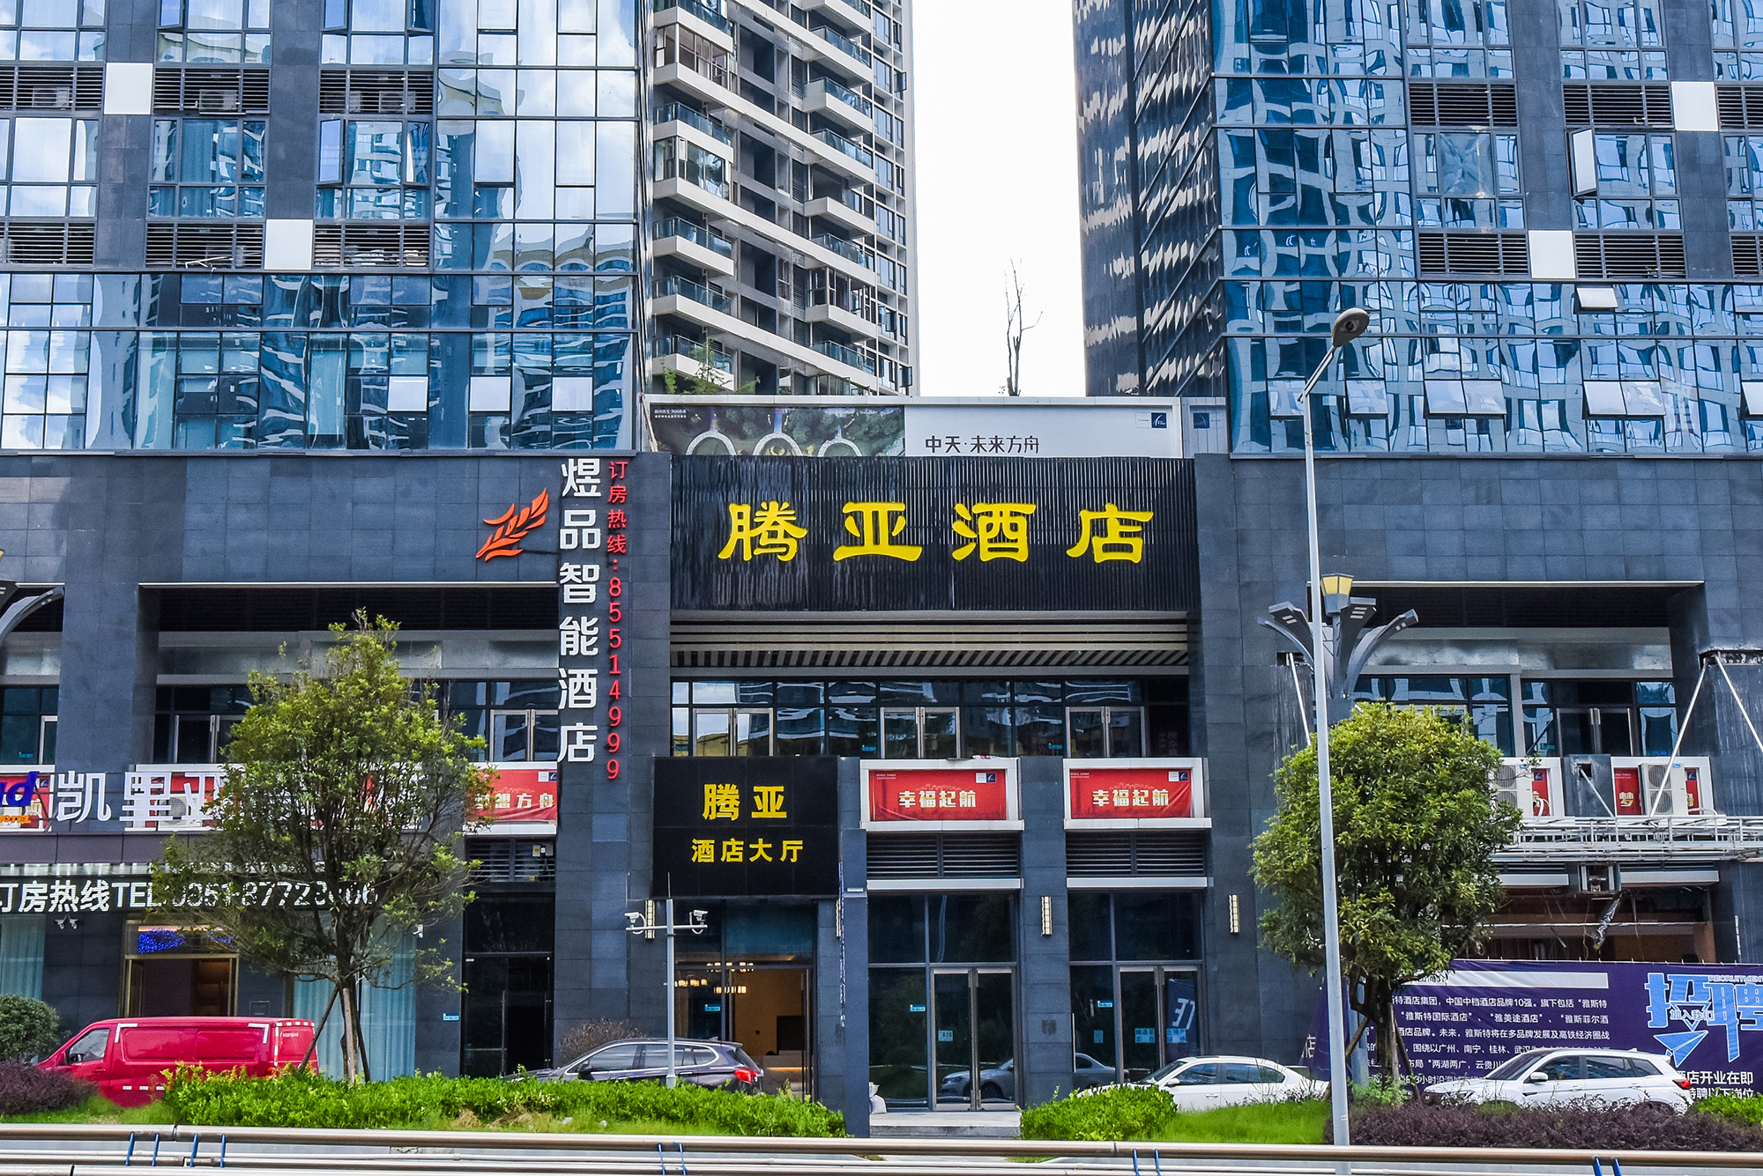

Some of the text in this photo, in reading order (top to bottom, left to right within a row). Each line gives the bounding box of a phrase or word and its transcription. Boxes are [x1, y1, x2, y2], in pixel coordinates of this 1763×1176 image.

[925, 435, 1039, 453] 中天·未来方舟
[717, 500, 1154, 564] 腾亚酒店
[557, 458, 602, 763] 煜品智能酒店
[702, 783, 787, 820] 腾亚
[898, 789, 976, 808] 幸福起航
[1092, 788, 1169, 807] 幸福起航
[691, 837, 803, 863] 酒店大厅
